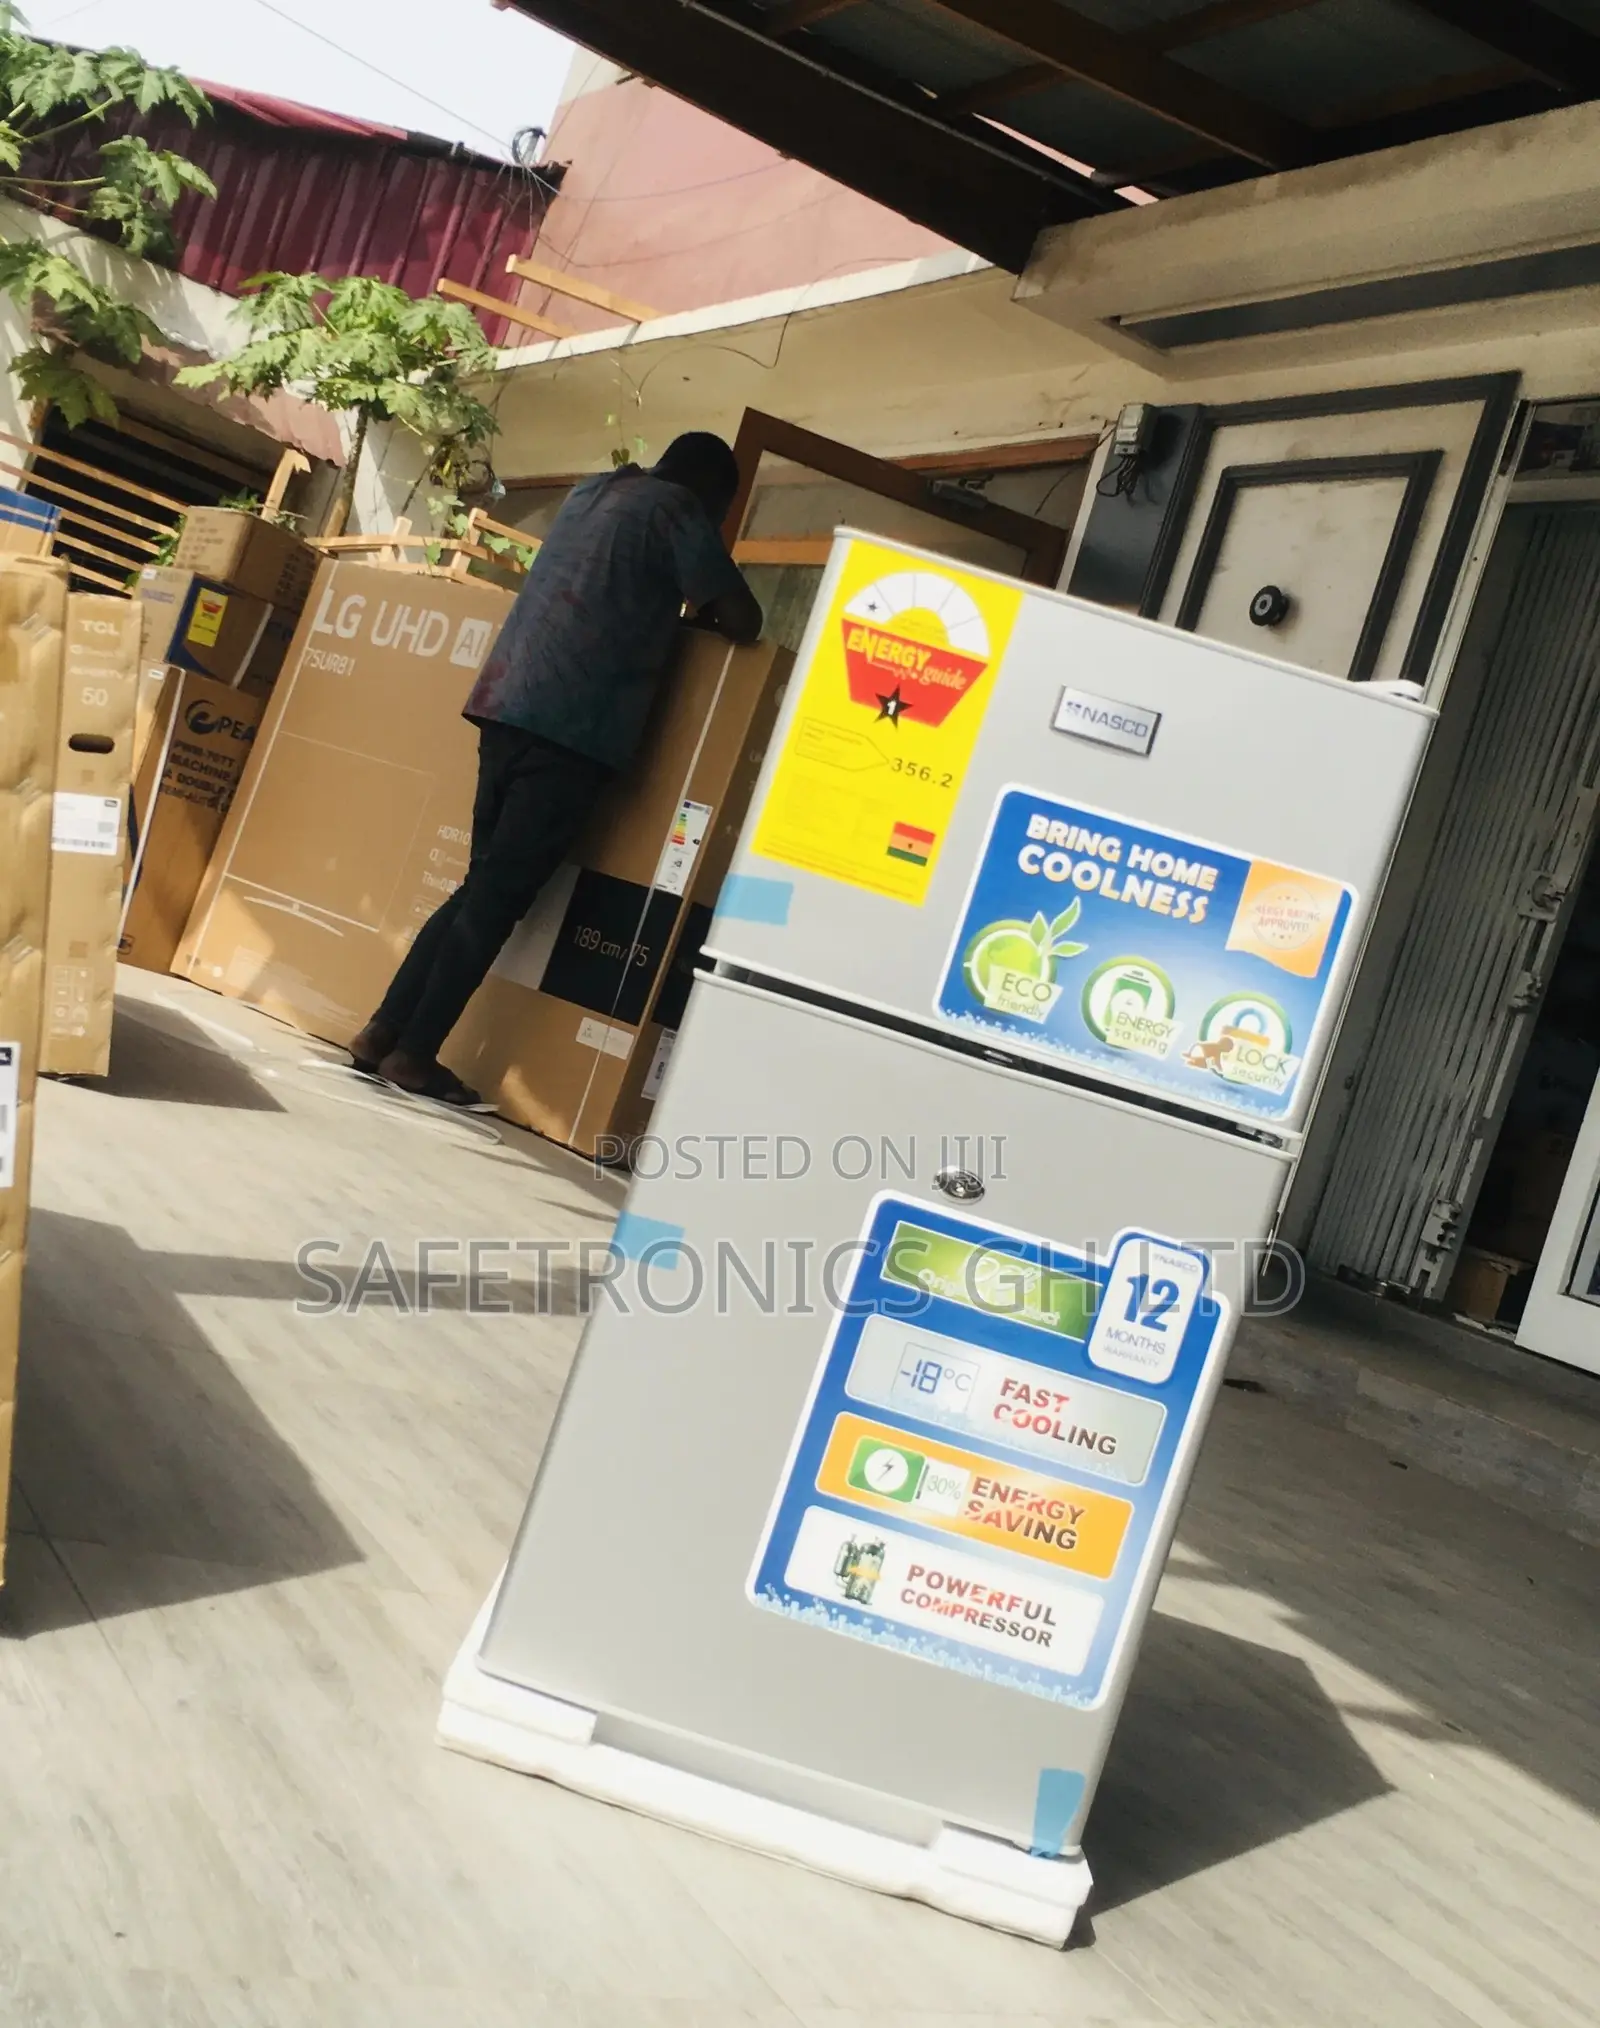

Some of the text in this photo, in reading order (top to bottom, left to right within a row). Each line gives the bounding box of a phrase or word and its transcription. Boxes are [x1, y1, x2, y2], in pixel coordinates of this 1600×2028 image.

[78, 619, 120, 636] TCL
[314, 588, 486, 658] LG UHD AI
[846, 627, 932, 671] ENERGY
[919, 665, 967, 690] guide
[887, 701, 897, 716] 1
[1082, 706, 1148, 738] NASCO
[891, 757, 953, 788] 356.2
[1026, 813, 1219, 892] BRING HOME
[1018, 843, 1209, 924] COOLNESS
[574, 926, 601, 950] 189
[1002, 972, 1052, 1002] ECO
[997, 994, 1045, 1018] friendly
[1116, 1011, 1176, 1038] ENERGY
[1114, 1027, 1169, 1055] saving
[1236, 1045, 1292, 1076] LOCK
[1231, 1065, 1285, 1088] security
[1126, 1273, 1180, 1332] 12
[1106, 1326, 1166, 1355] MONTHS
[1000, 1377, 1070, 1412] FAST
[993, 1403, 1117, 1455] COOLING
[926, 1475, 962, 1500] 30%
[971, 1477, 1085, 1525] ENERGY
[964, 1499, 1077, 1550] SAVING
[906, 1564, 1057, 1627] POWERFUL
[901, 1588, 1053, 1647] COMPRESSOR
